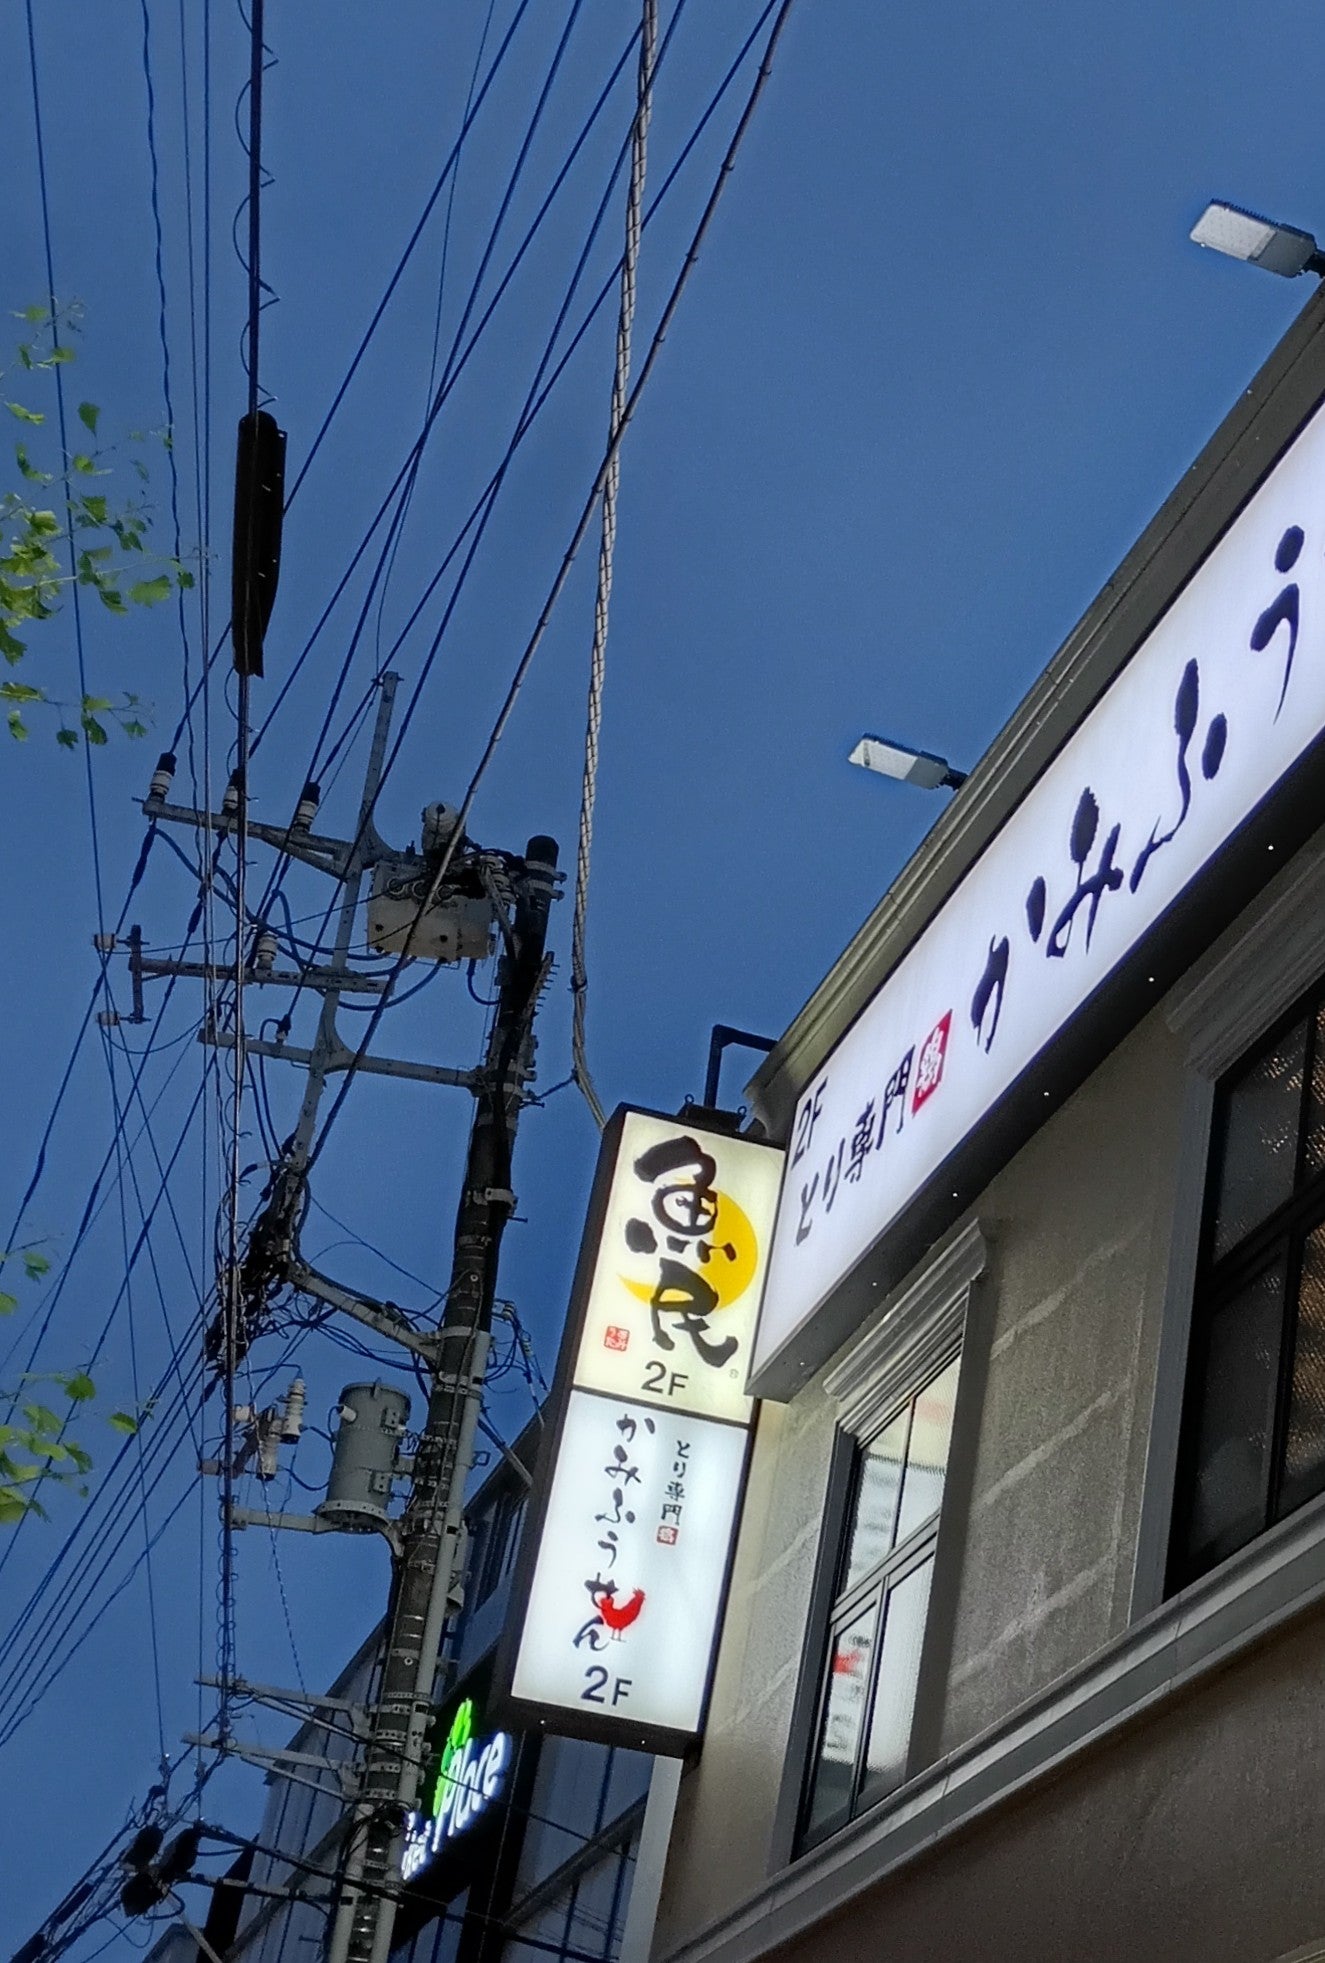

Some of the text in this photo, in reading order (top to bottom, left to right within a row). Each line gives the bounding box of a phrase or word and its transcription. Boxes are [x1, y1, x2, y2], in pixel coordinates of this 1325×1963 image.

[790, 1076, 828, 1170] 2F
[795, 1044, 915, 1246] とり専門
[641, 1360, 689, 1397] 2F
[660, 1440, 691, 1526] とり専門
[580, 1665, 633, 1706] 2F
